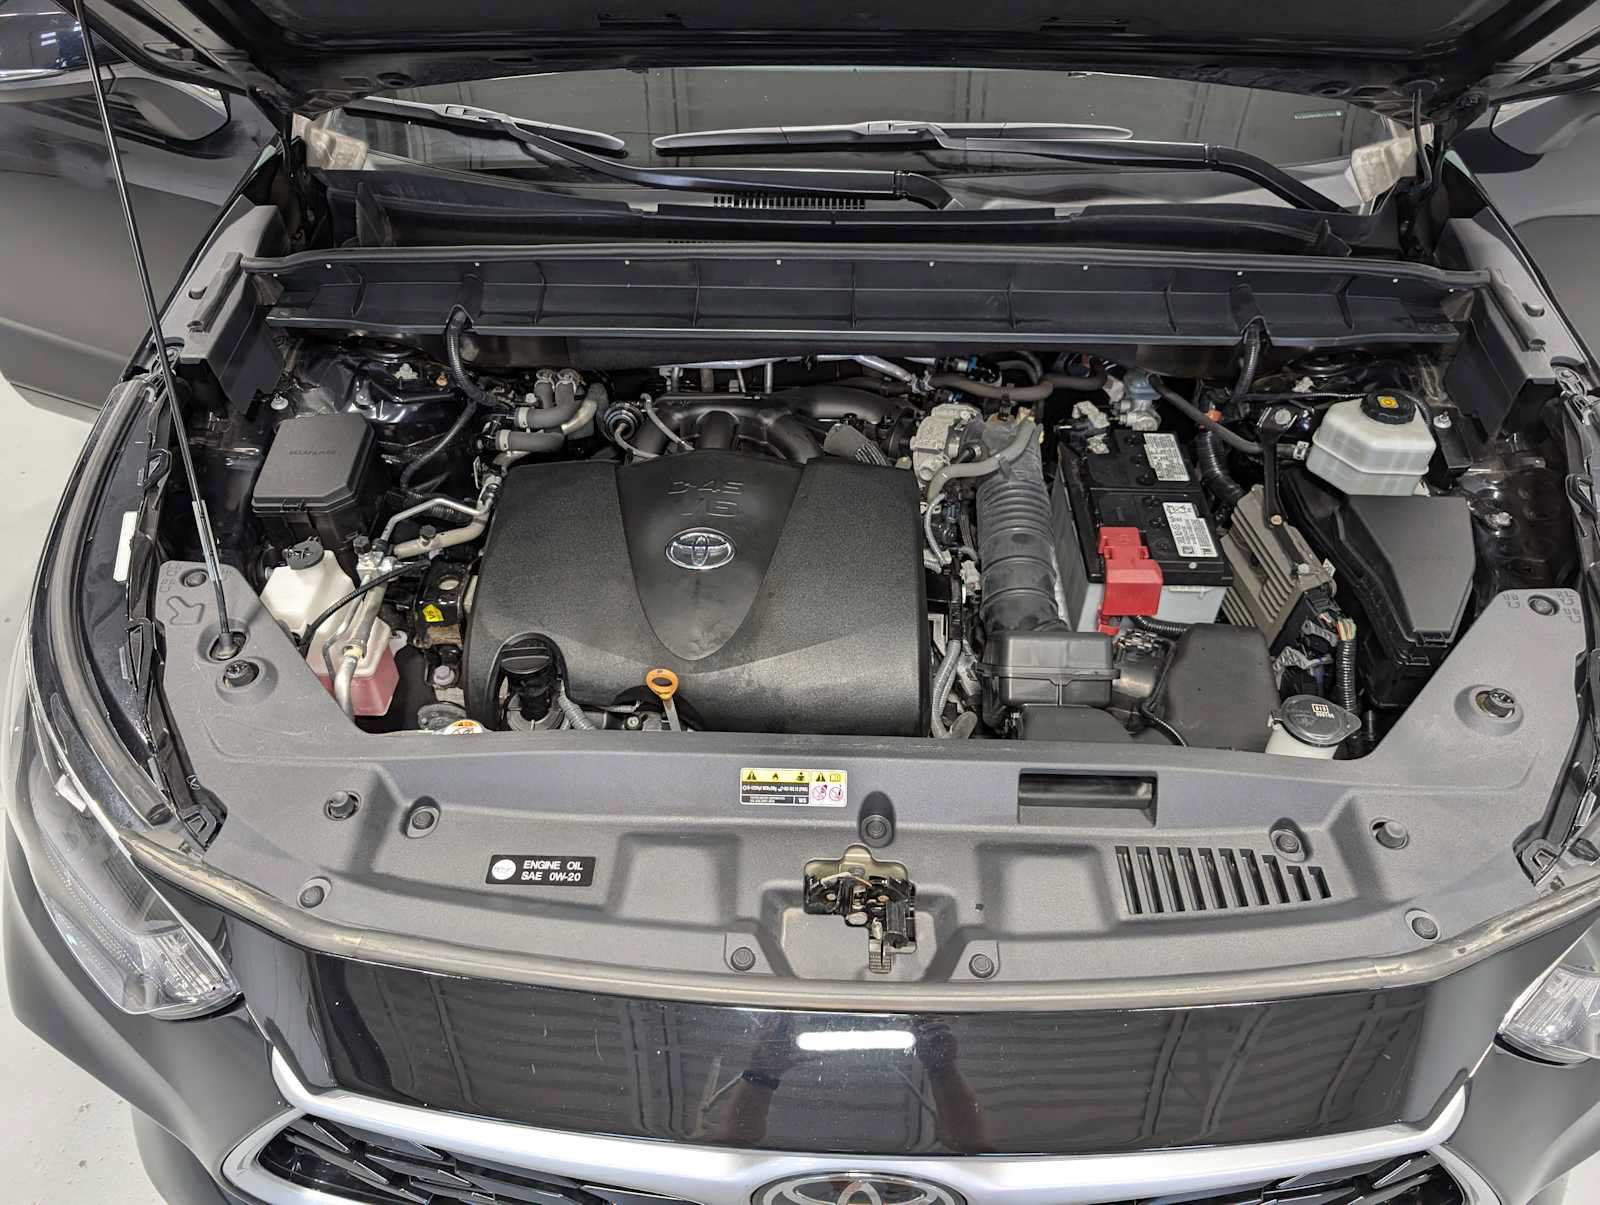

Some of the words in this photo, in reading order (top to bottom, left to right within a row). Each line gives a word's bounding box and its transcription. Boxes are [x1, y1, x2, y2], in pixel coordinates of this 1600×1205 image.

[523, 860, 561, 870] ENGINE
[566, 861, 583, 870] OIL
[521, 871, 543, 880] SAE
[549, 872, 581, 882] 0W-20
